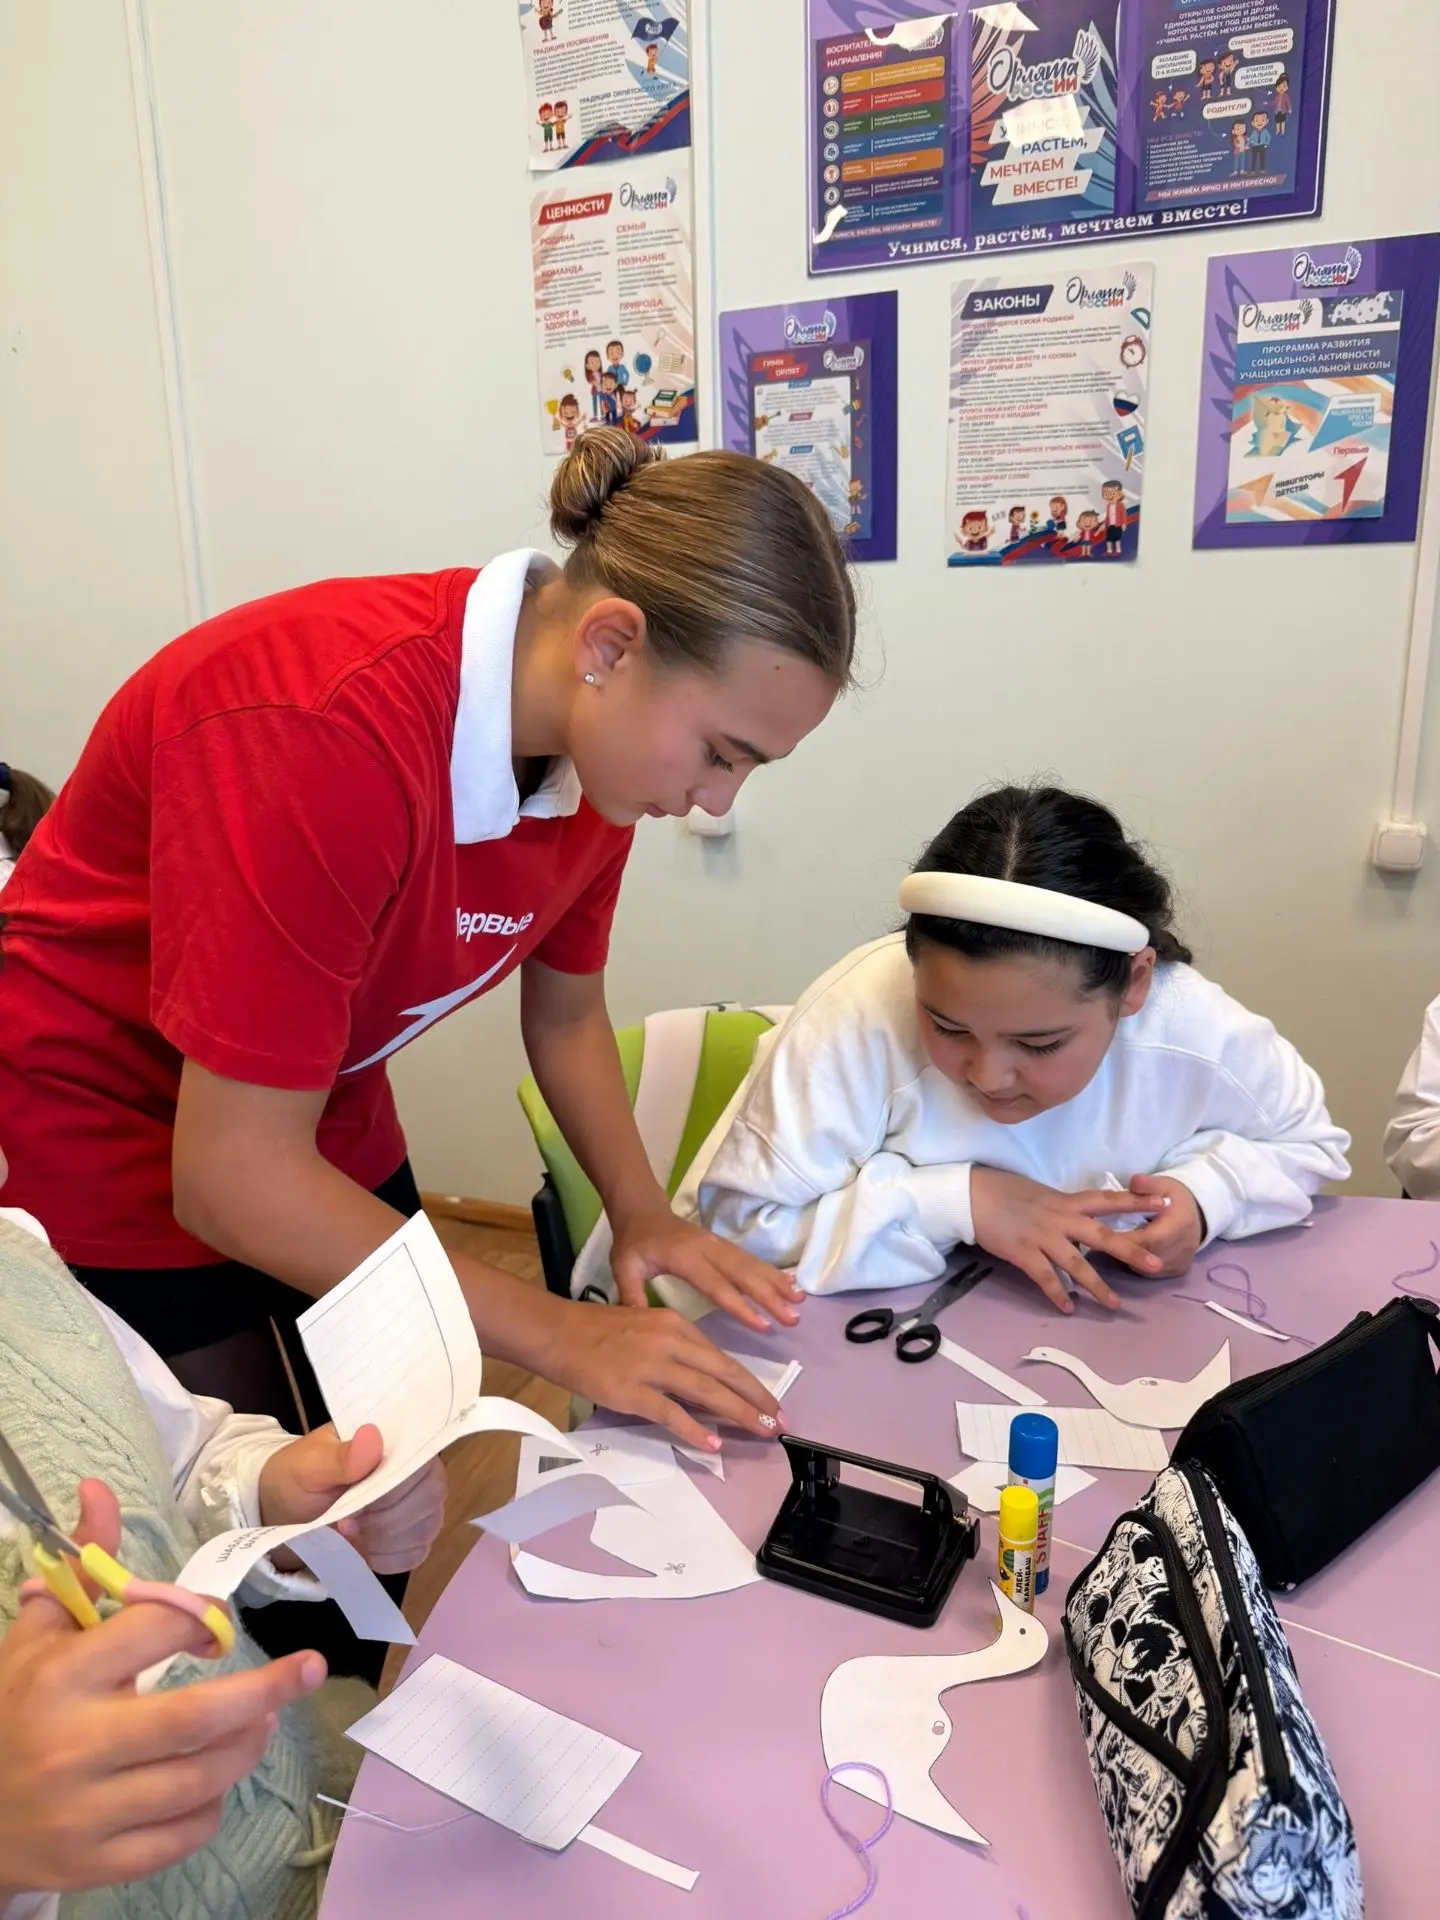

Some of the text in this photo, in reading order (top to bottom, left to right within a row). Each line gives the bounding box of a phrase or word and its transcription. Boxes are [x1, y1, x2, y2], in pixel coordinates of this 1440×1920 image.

[1179, 0, 1264, 20] ОТКРЫТОЕ СООБЩЕСТВО
[1164, 12, 1242, 29] ЕДИНОМЫШЛЕННИКОВ
[1167, 26, 1198, 36] КОТОРОЕ
[1242, 13, 1275, 24] ДЕВИЗОМ
[1220, 24, 1252, 34] МЕЧТАЕМ
[826, 40, 872, 55] ВОСПИТАТЕ
[826, 50, 882, 68] НАПРАВЛЕНИЯ
[1206, 104, 1248, 114] РОДИТЕЛИ
[990, 157, 1064, 179] МЕЧТАЕМ
[1013, 176, 1078, 196] ВМЕСТЕ!
[546, 200, 606, 221] ЦЕННОСТИ
[616, 222, 646, 234] СЕМЬЯ
[888, 198, 1248, 258] Учимся, растём, мечтаем вместе!
[540, 234, 575, 247] РОДИНА
[617, 252, 666, 267] ПОЗНАНИЕ
[541, 264, 584, 279] КОМАНДА
[620, 298, 664, 312] ПРИРОДА
[973, 294, 1040, 312] ЗАКОНЫ
[544, 310, 579, 322] СПОРТ И
[544, 318, 588, 332] ЗДОРОВЬЕ
[1262, 338, 1370, 354] ПРОГРАММА РАЗВИТИЯ
[1252, 349, 1380, 367] СОЦИАЛЬНОЙ АКТИВНОСТИ
[1240, 360, 1391, 380] УЧАЩИХСЯ НАЧАЛЬНОЙ ШКОЛЫ
[1275, 483, 1308, 498] ДЕТСТВА
[456, 906, 534, 942] ервые
[1036, 1508, 1050, 1565] STAFF
[1014, 1568, 1023, 1594] КЛЕЙ-
[1024, 1557, 1032, 1602] КАРАНДАШ
